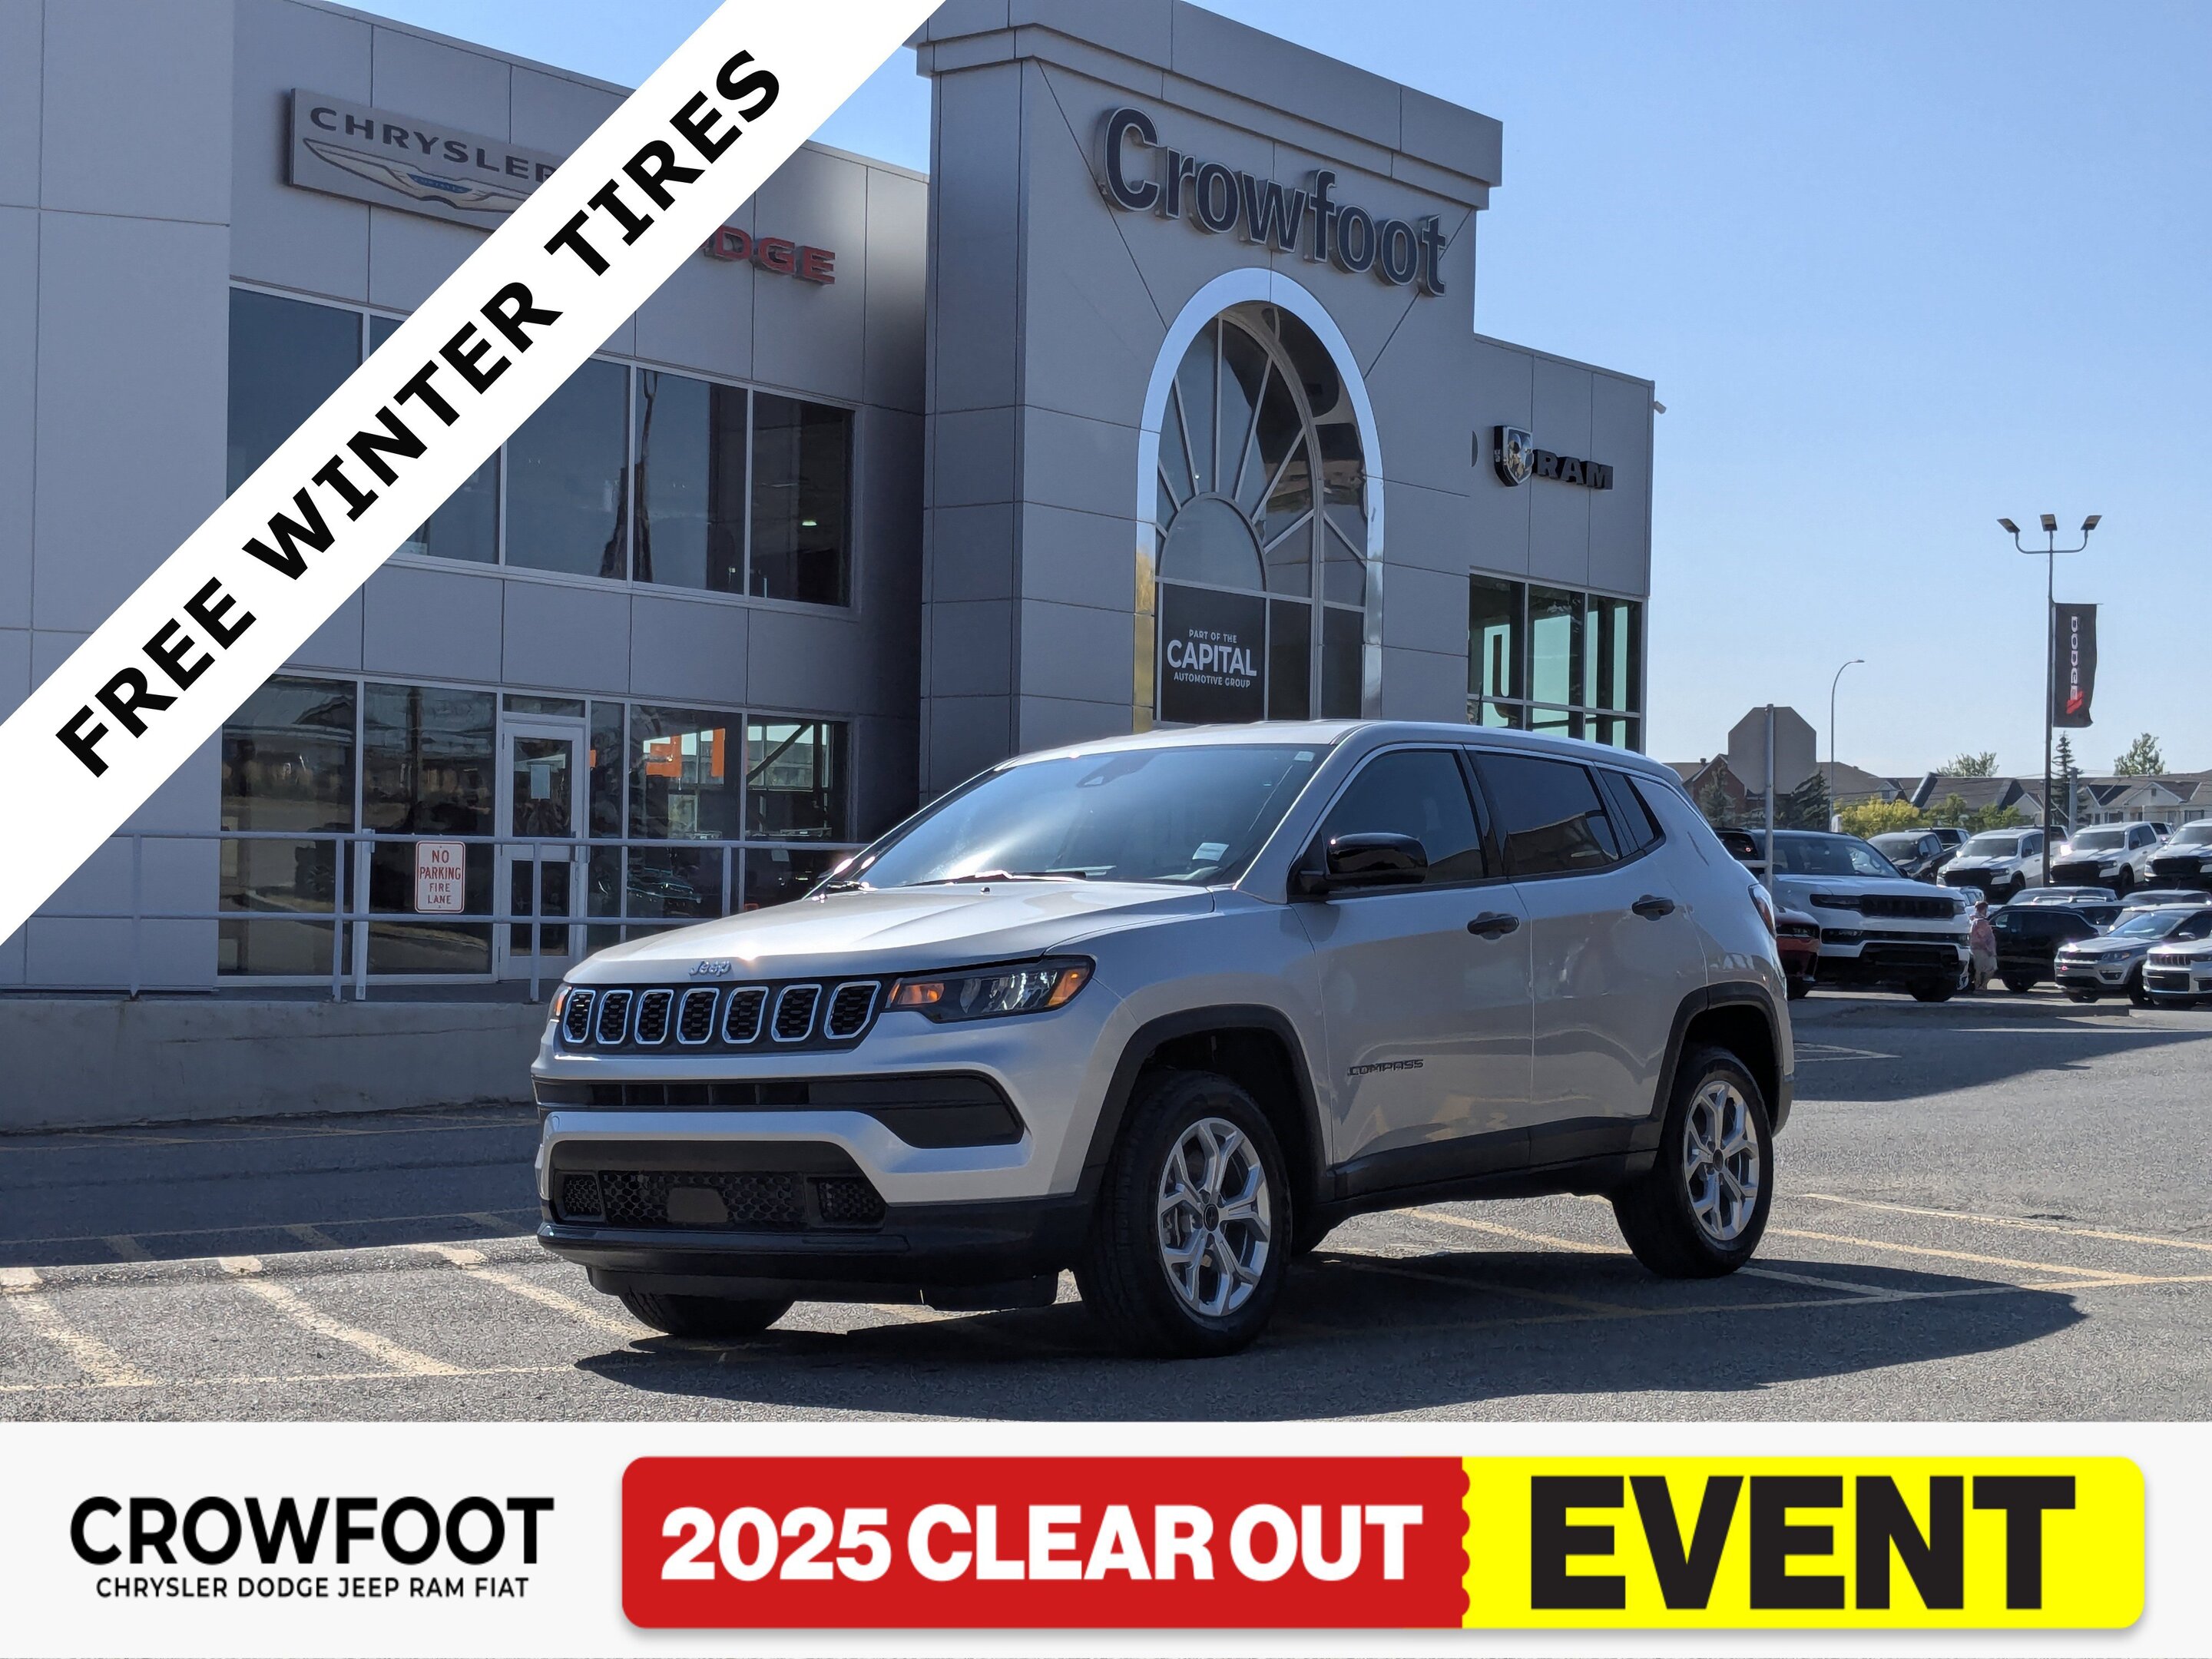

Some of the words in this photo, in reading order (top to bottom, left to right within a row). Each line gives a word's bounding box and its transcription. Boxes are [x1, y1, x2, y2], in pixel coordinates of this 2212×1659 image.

[1095, 106, 1447, 296] Crowfoot
[698, 225, 836, 285] DGE
[1533, 449, 1613, 490] RAM
[1189, 629, 1208, 640] PART
[1210, 631, 1220, 641] OF
[1223, 634, 1237, 644] THE
[1167, 639, 1257, 677] CAPITAL
[1174, 672, 1223, 685] AUTOMOTIVE
[1225, 677, 1250, 688] GROUP
[432, 849, 449, 863] NO
[419, 866, 462, 879] PARKING
[430, 883, 451, 892] FIRE
[428, 895, 452, 904] LANE
[688, 960, 732, 977] Jeep
[1347, 1059, 1424, 1076] COMPASS
